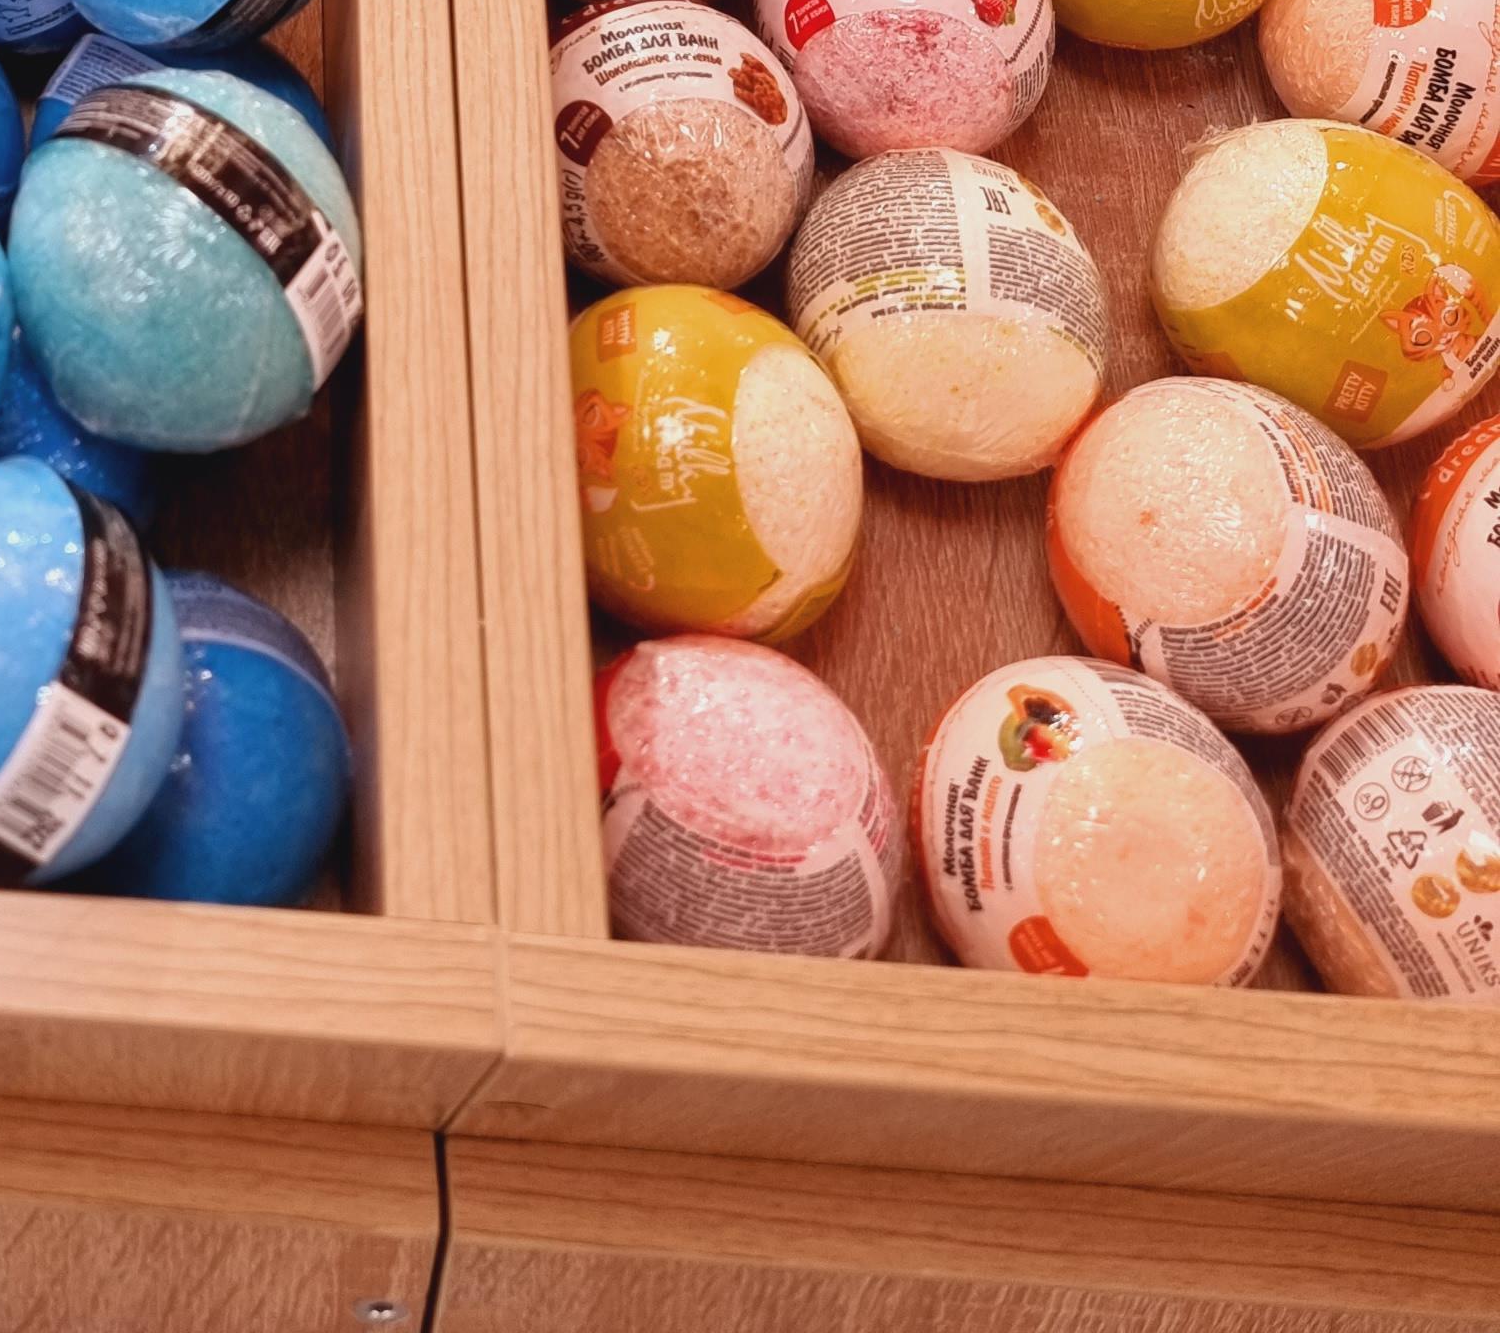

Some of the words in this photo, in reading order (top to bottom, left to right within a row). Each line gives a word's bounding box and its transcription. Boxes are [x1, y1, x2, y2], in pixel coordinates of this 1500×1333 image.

[579, 41, 637, 73] БОМБА
[676, 25, 720, 56] ВАНН
[1433, 46, 1458, 96] БОМБА
[1426, 91, 1447, 129] ДЛЯ
[1427, 80, 1477, 154] Молочная
[1351, 234, 1396, 294] dream
[1333, 372, 1364, 412] PRETTY
[1353, 380, 1379, 415] KITTY
[967, 756, 990, 802] ВАНН
[962, 797, 975, 838] ДЛЯ
[963, 825, 980, 914] БОМБА
[1455, 924, 1500, 988] UNIKS
